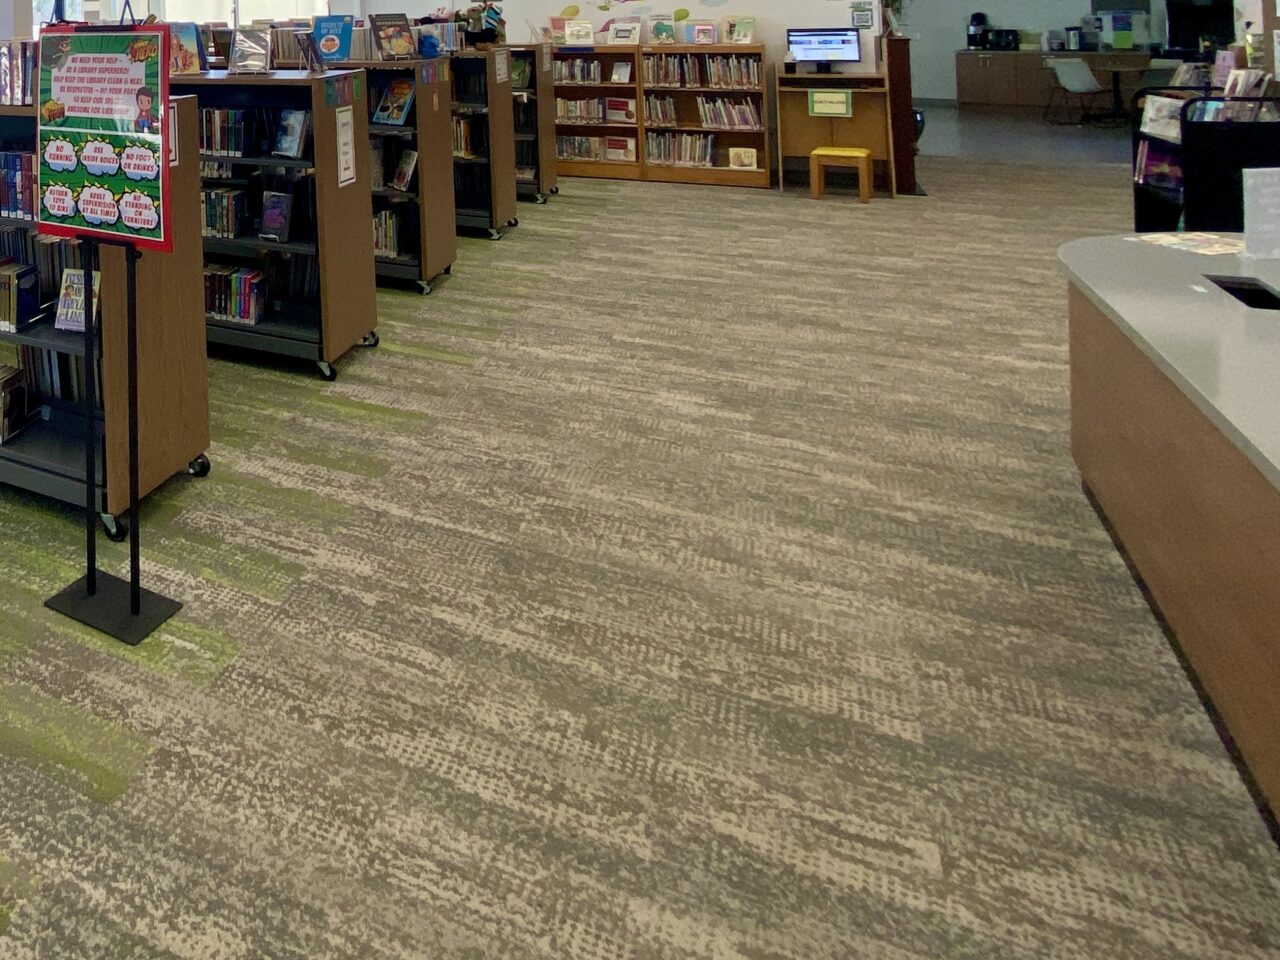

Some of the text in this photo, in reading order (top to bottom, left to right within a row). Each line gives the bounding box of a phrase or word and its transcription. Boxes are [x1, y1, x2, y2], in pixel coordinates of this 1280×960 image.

[49, 154, 73, 162] RUNNING
[100, 156, 119, 164] VOICES
[132, 164, 154, 172] DRINKS
[49, 189, 68, 197] RETURN
[82, 200, 116, 210] SUPERVISION
[125, 201, 152, 210] STANDING
[100, 208, 116, 218] TIMES
[124, 217, 153, 226] FURNITURE
